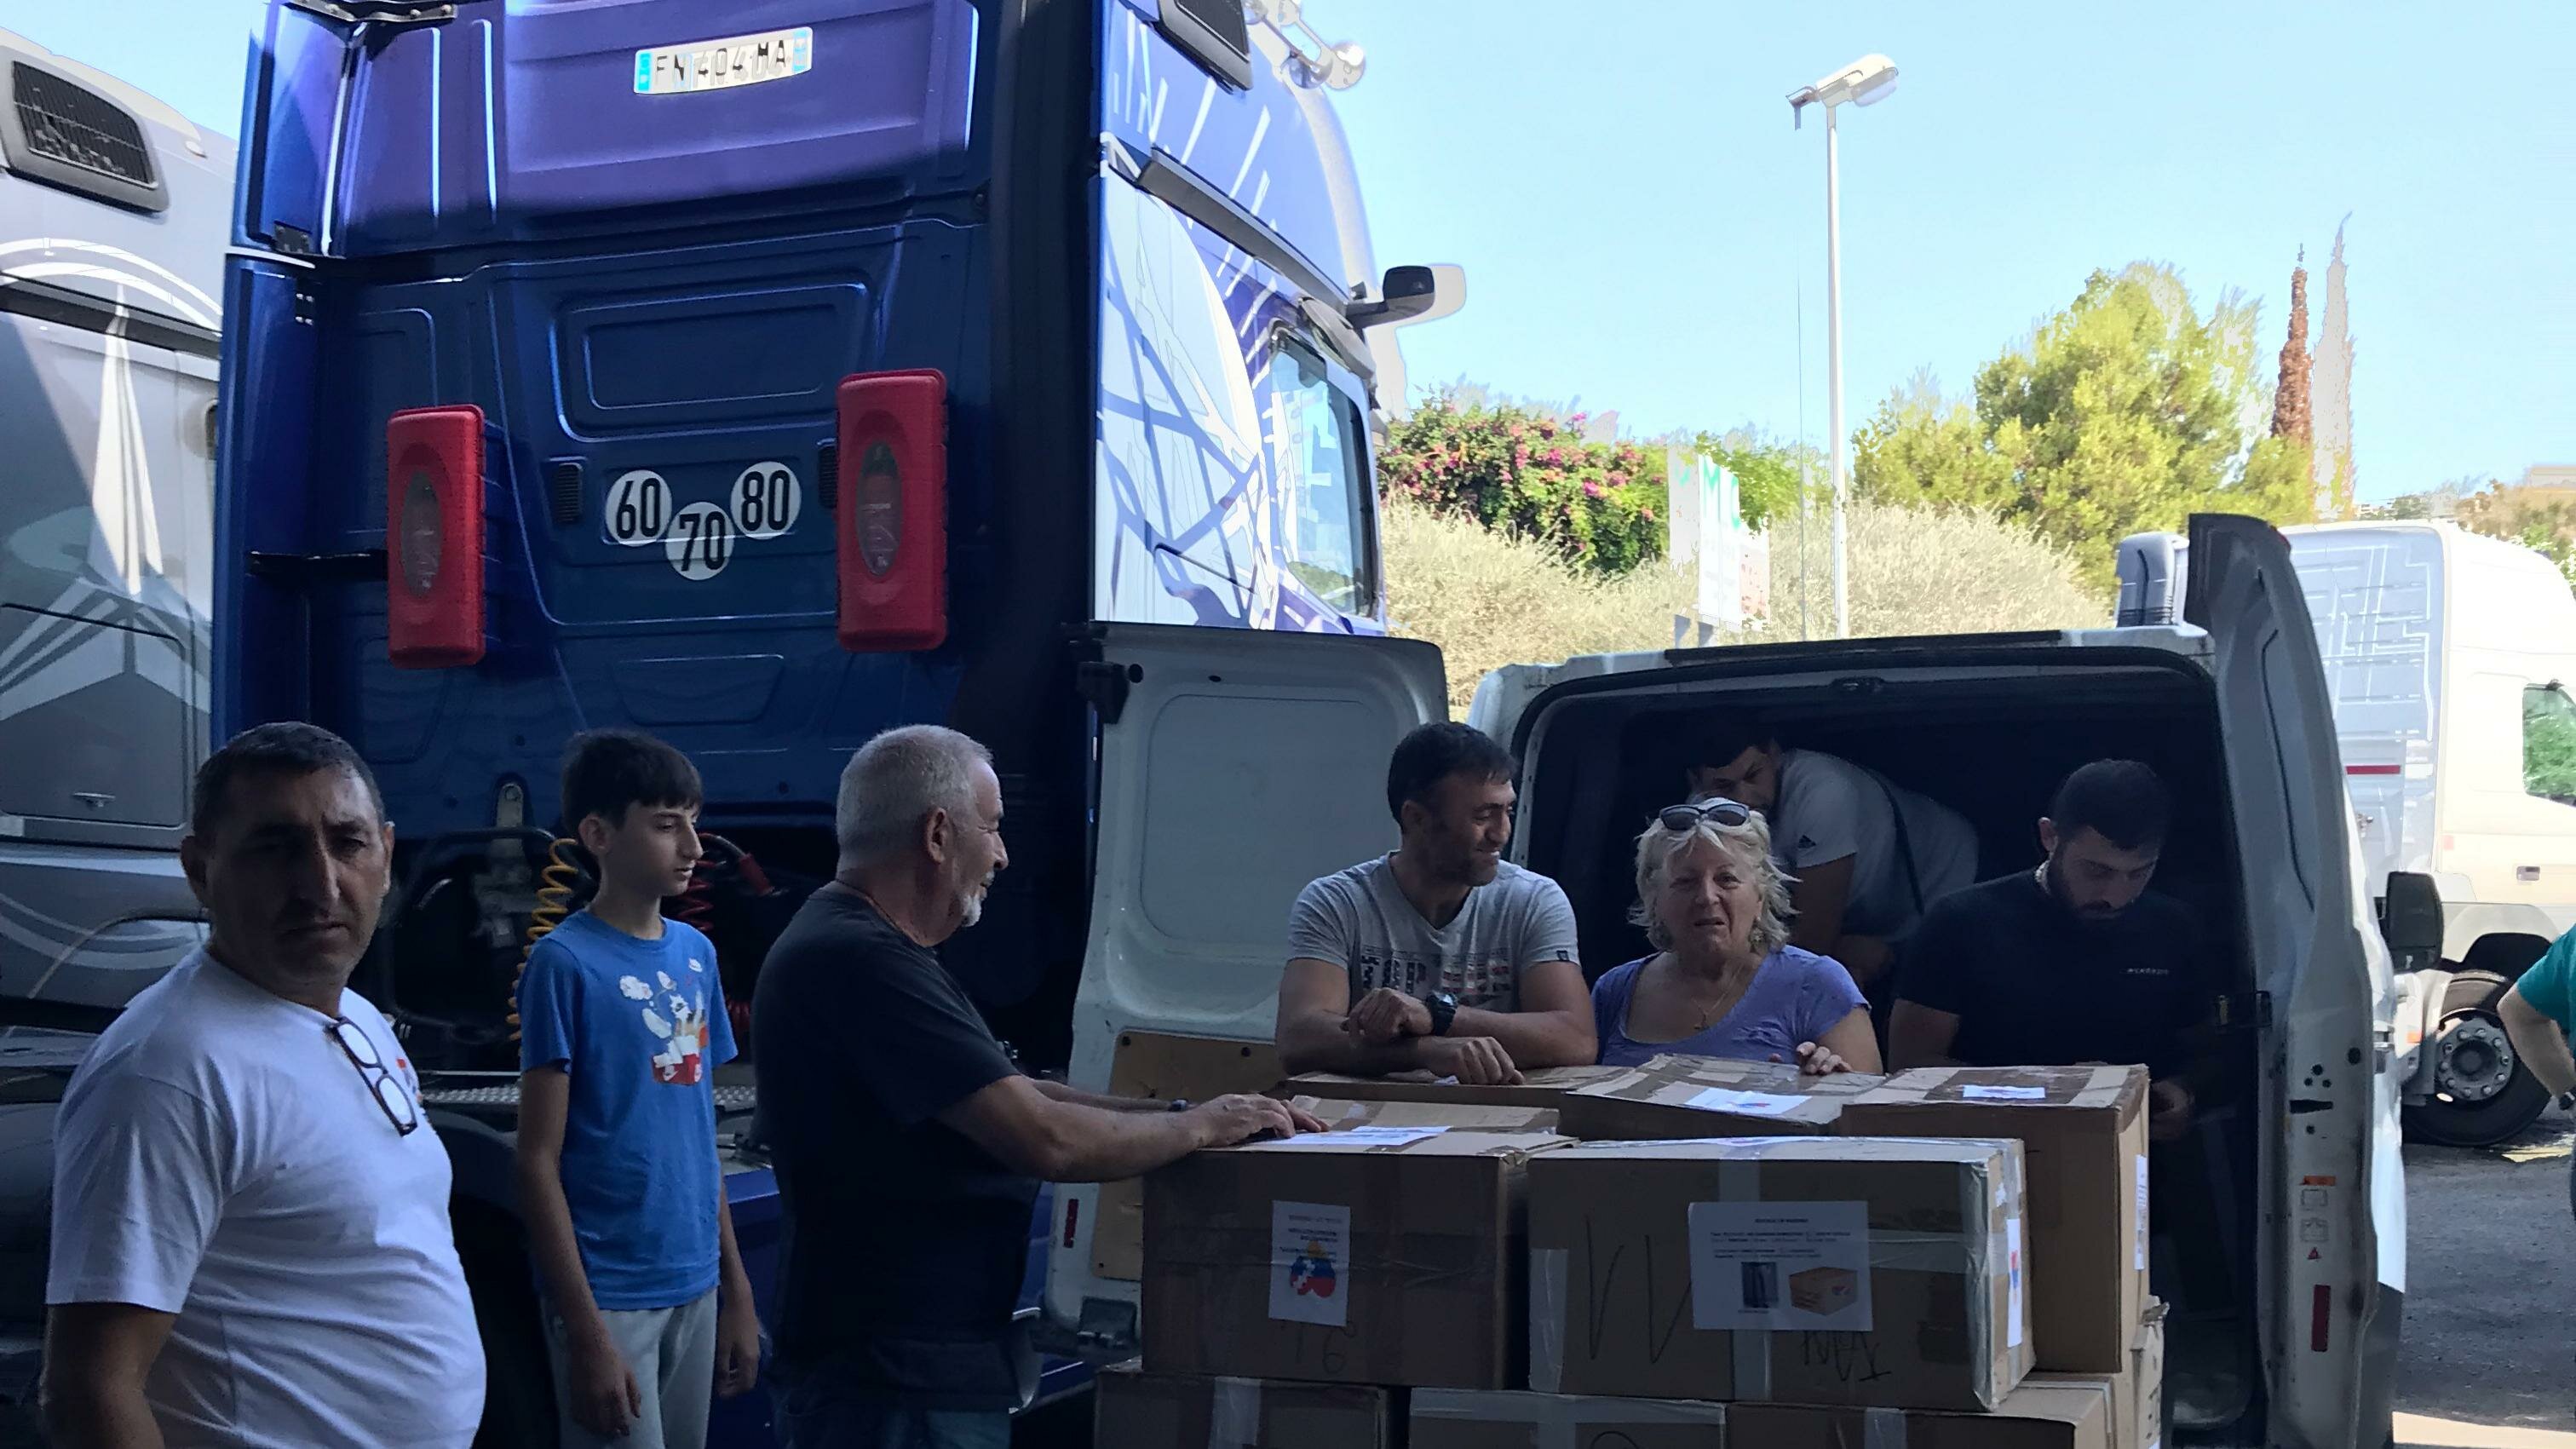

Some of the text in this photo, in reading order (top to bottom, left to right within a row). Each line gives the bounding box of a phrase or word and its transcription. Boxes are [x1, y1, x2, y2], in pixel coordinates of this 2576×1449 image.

[655, 54, 687, 84] FN
[616, 477, 661, 539] 60
[741, 469, 791, 532] 80
[679, 511, 726, 572] 70
